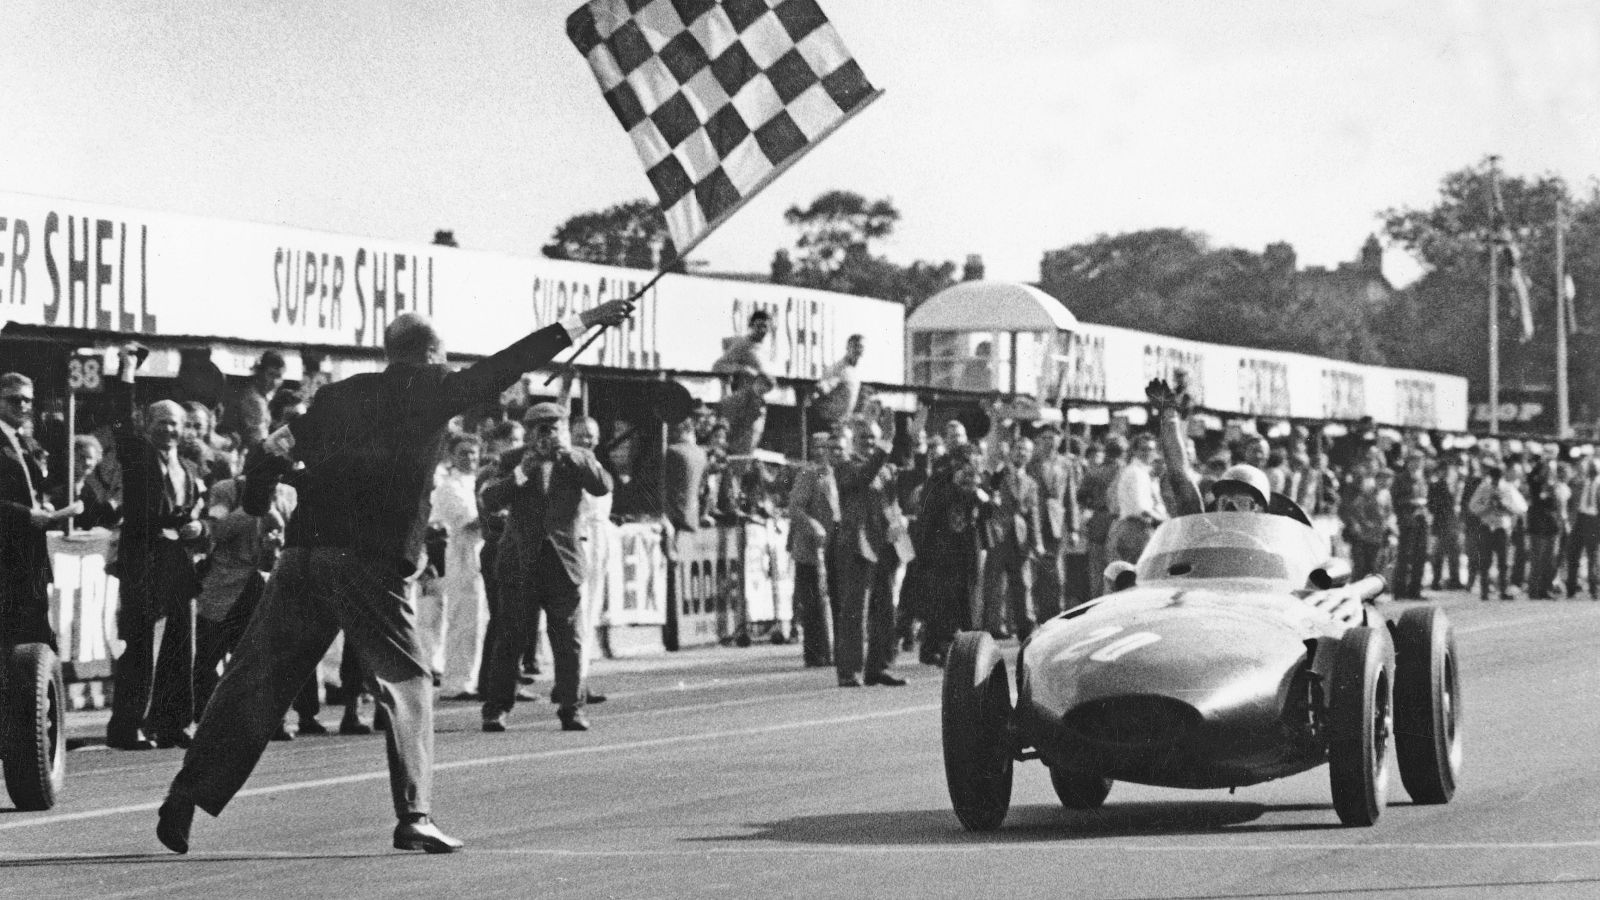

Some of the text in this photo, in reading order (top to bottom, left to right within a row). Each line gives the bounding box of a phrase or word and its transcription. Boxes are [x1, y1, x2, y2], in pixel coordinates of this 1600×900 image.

[43, 210, 156, 334] SHELL
[272, 247, 344, 330] SUPER
[69, 359, 100, 388] 38
